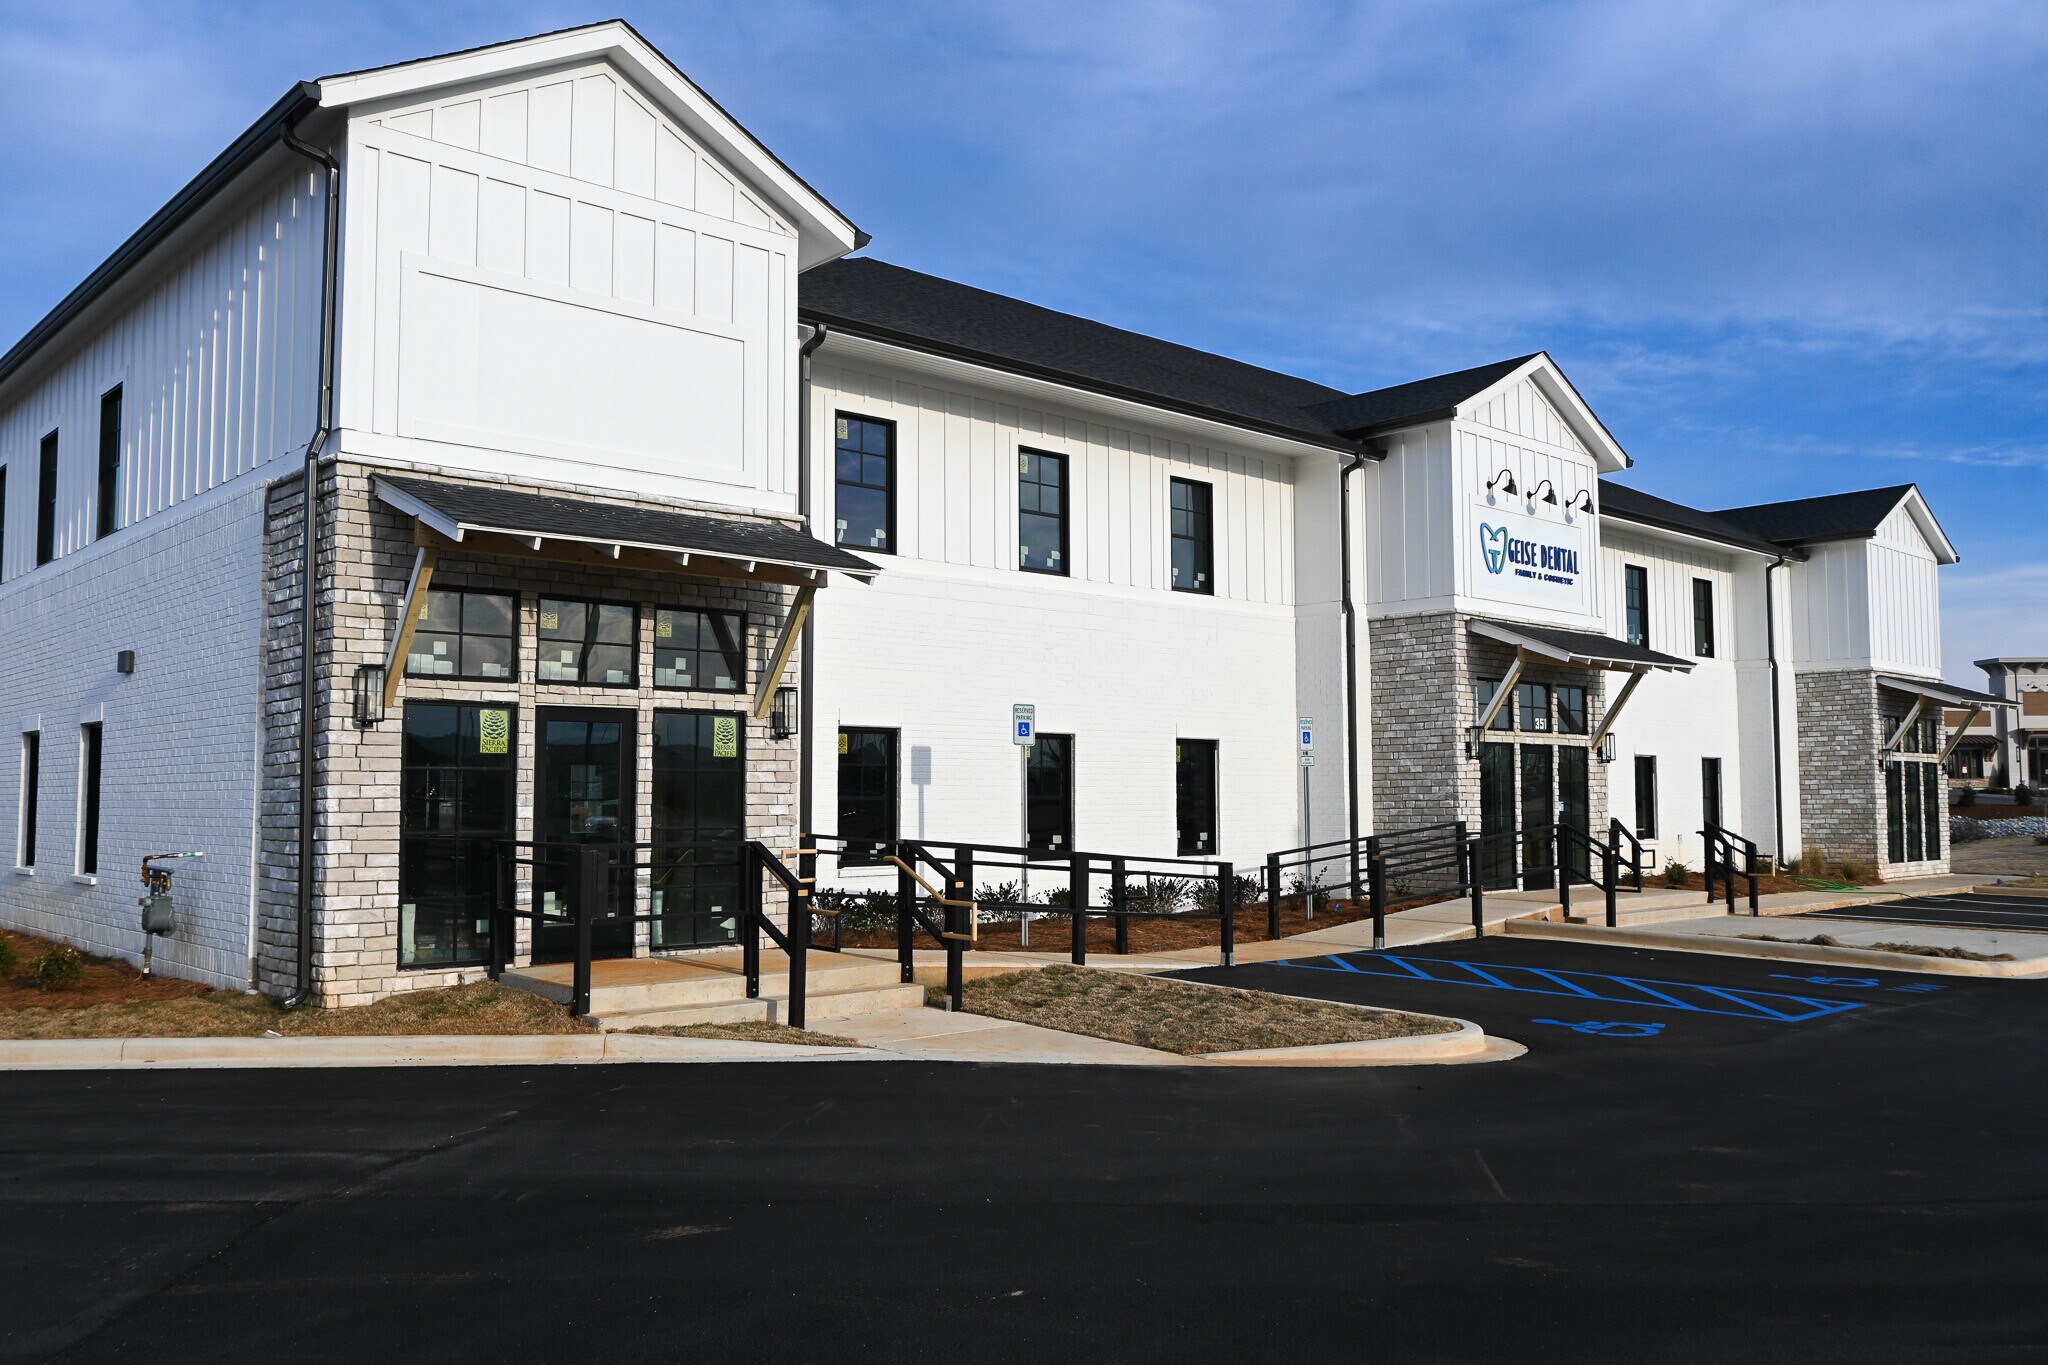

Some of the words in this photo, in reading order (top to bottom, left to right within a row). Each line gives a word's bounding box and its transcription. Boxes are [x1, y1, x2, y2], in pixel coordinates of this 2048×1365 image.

[1508, 537, 1537, 567] GEISE
[1540, 544, 1580, 575] DENTAL
[1514, 568, 1537, 580] FAMILY
[1537, 573, 1542, 581] &
[1543, 573, 1574, 586] COSMETIC
[1534, 717, 1547, 730] 351
[482, 738, 506, 747] SIERRA
[715, 743, 735, 751] SIERRA
[481, 745, 507, 753] PACIFIC
[714, 749, 736, 757] PACIFIC
